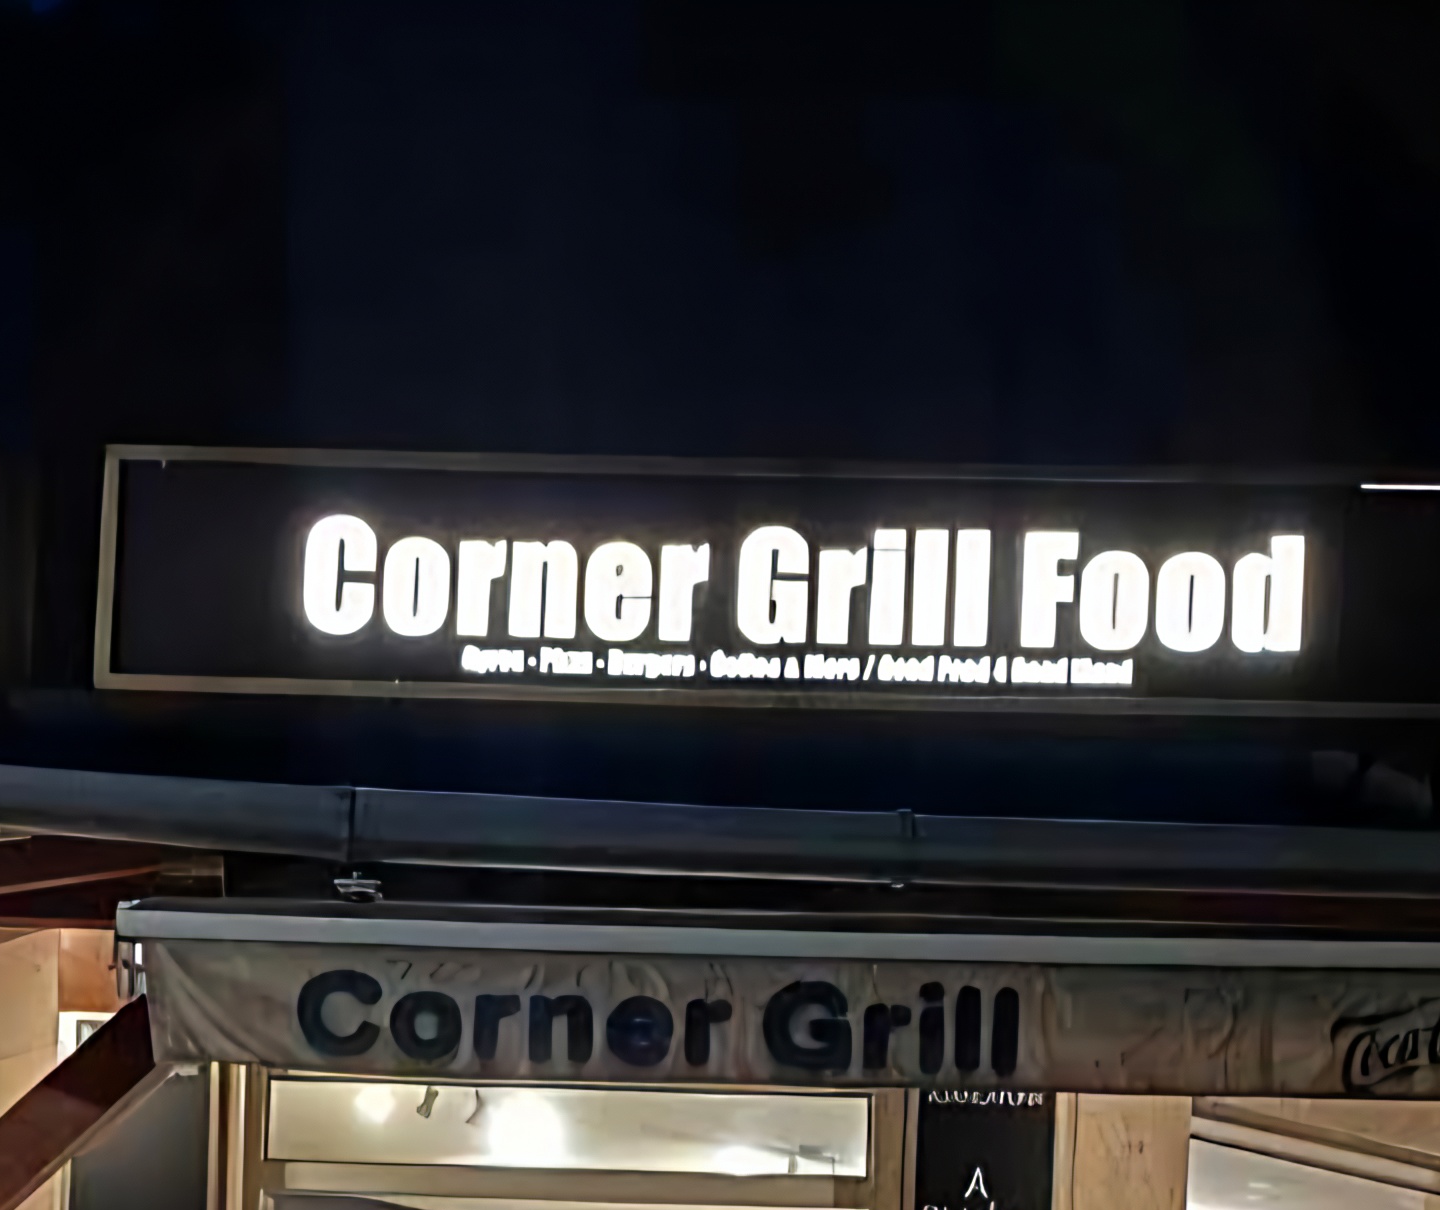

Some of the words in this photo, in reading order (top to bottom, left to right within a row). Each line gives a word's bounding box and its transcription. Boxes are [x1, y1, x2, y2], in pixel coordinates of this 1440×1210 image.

[303, 514, 710, 641] Corner
[737, 526, 991, 647] Grill
[1020, 530, 1305, 653] Food
[297, 969, 732, 1067] Corner
[763, 981, 1020, 1078] Grill
